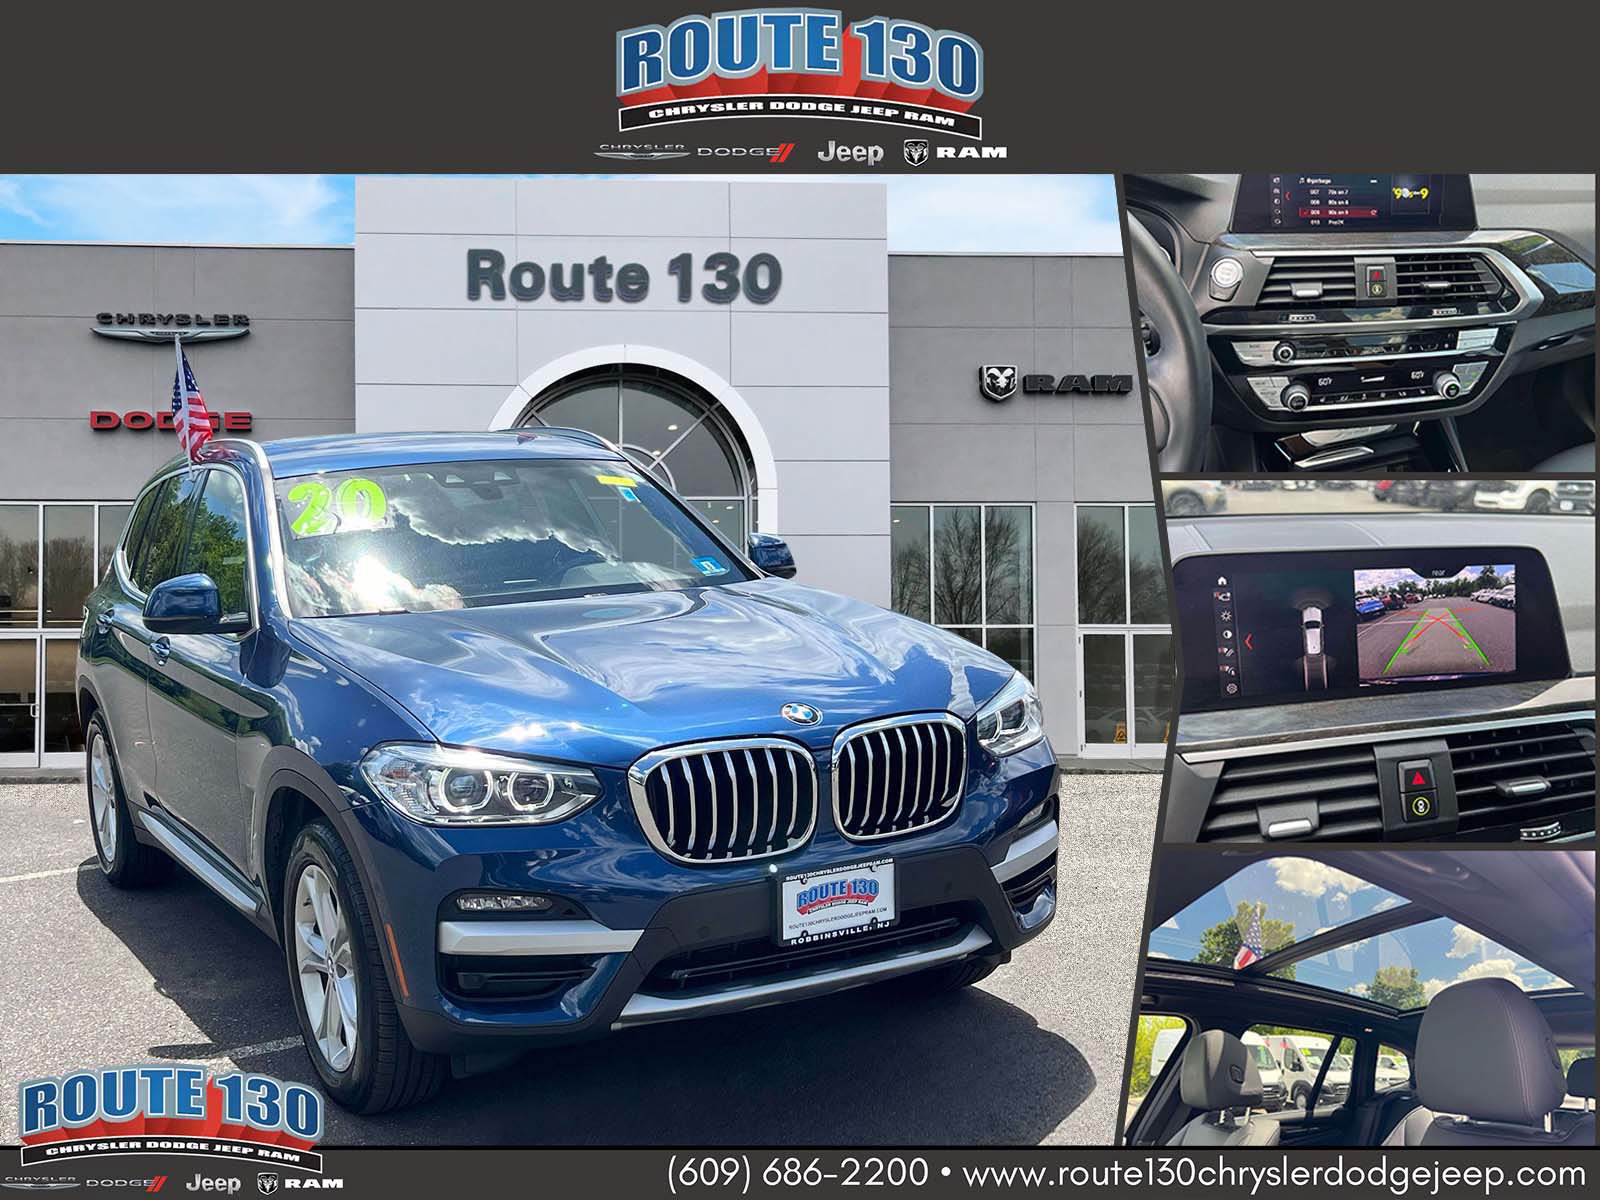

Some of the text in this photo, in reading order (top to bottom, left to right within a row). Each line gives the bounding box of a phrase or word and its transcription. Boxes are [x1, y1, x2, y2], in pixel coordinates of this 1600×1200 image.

[467, 248, 783, 304] Route 130
[96, 312, 250, 326] CHRYSLER
[1022, 374, 1133, 393] RAM
[288, 477, 387, 535] 20
[797, 879, 848, 908] ROUTE
[850, 878, 880, 896] 130
[791, 921, 890, 946] ROBBINSVILLE, NJ
